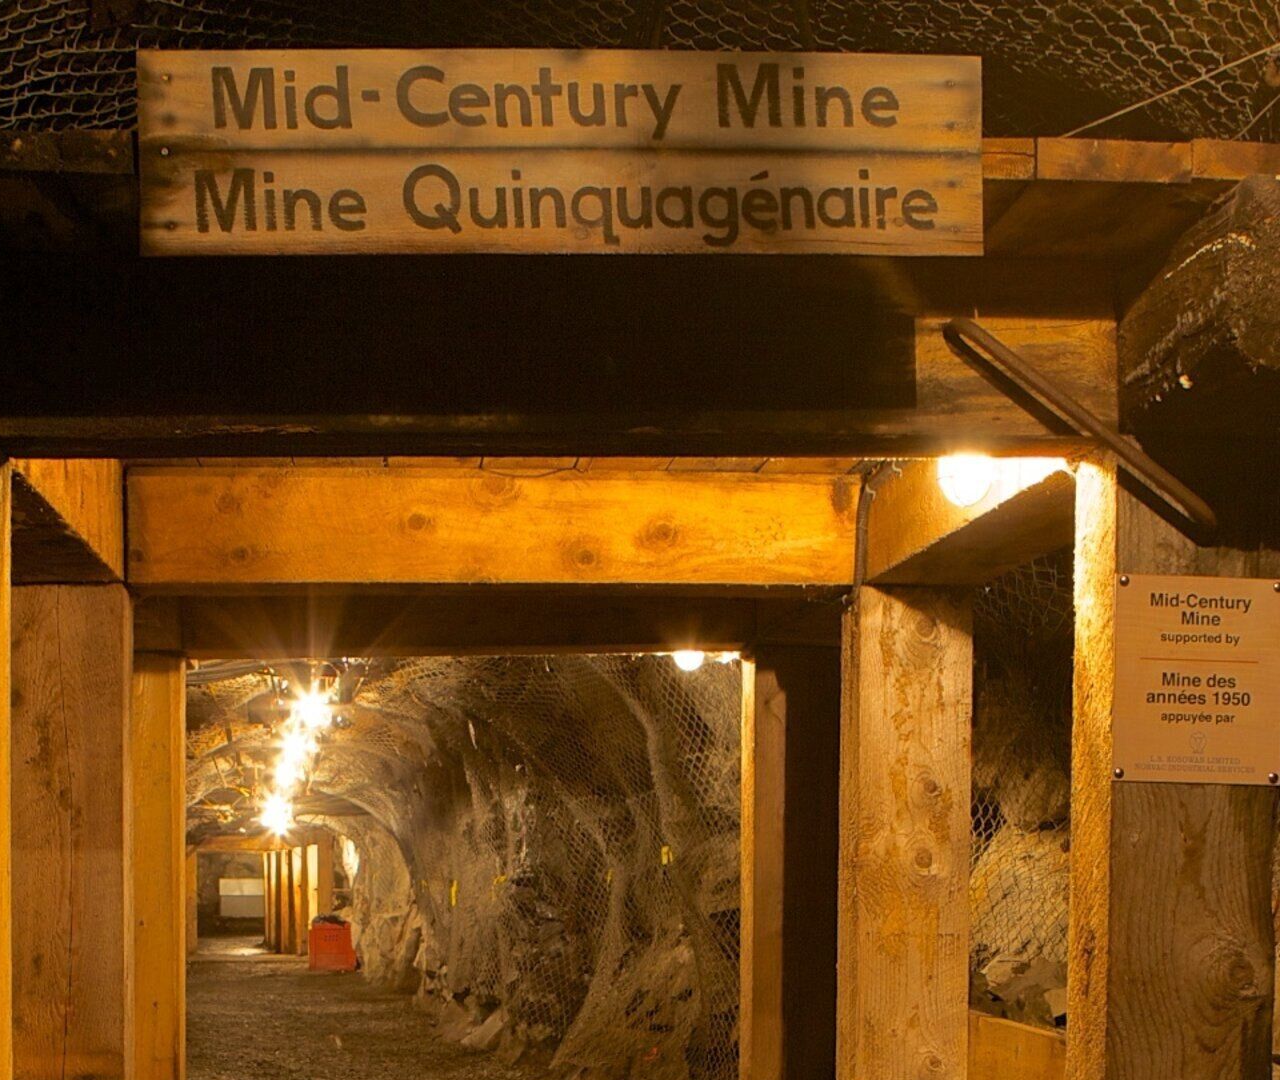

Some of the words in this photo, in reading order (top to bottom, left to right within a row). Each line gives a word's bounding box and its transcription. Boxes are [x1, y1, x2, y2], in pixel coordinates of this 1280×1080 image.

[211, 64, 683, 141] Mid-Century
[720, 62, 901, 129] Mine
[194, 168, 367, 234] Mine
[401, 163, 940, 247] Quinquagénaire
[1150, 592, 1252, 613] Mid-Century
[1181, 611, 1221, 626] Mine
[1160, 631, 1222, 644] supported
[1225, 633, 1240, 645] by
[1162, 672, 1201, 687] Mine
[1206, 673, 1236, 688] des
[1146, 690, 1206, 705] années
[1214, 692, 1251, 706] 1950
[1160, 711, 1212, 723] appuyée
[1215, 714, 1235, 725] par
